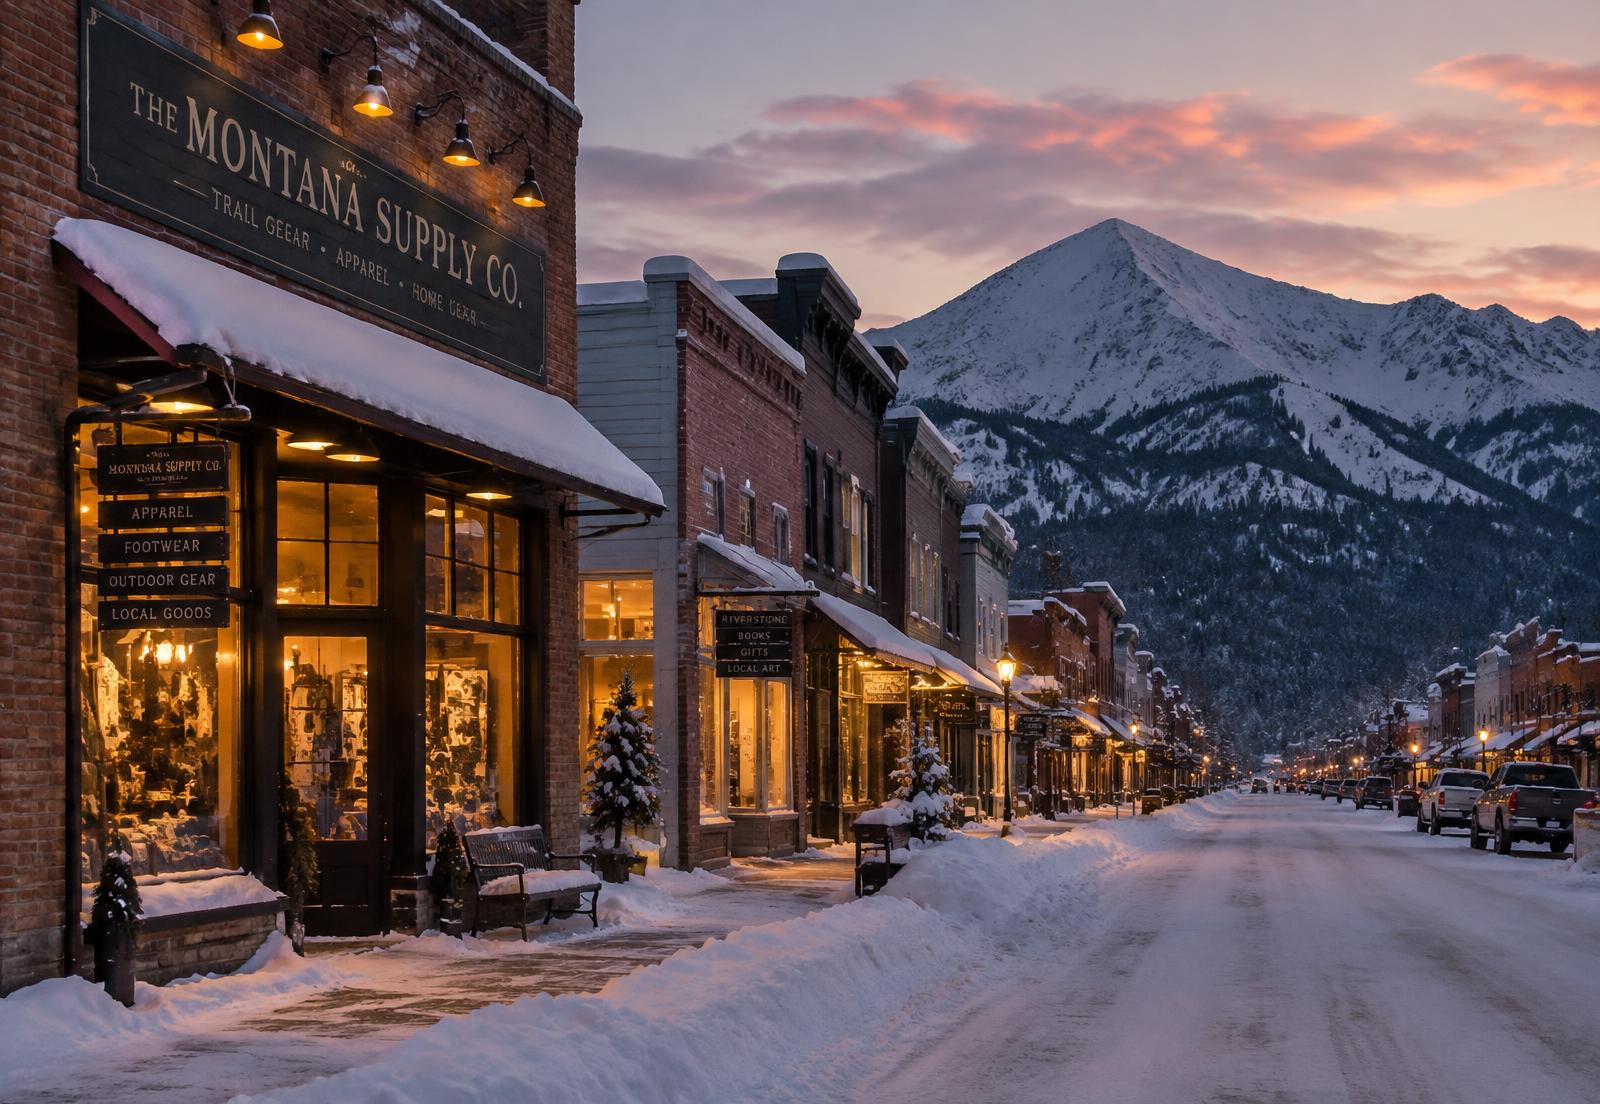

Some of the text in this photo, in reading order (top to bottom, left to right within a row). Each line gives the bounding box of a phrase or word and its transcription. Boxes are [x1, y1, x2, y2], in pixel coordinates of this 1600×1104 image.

[130, 81, 523, 309] THE MONTANA SUPPLY CO.
[336, 247, 390, 287] APPAREL
[131, 506, 193, 520] APPAREL
[124, 539, 200, 554] FOOTWEAR
[109, 573, 216, 587] OUTDOOR GEAR
[112, 606, 212, 620] LOCAL GOODS
[738, 631, 771, 640] BOOKS
[728, 664, 781, 673] LOCAL ART
